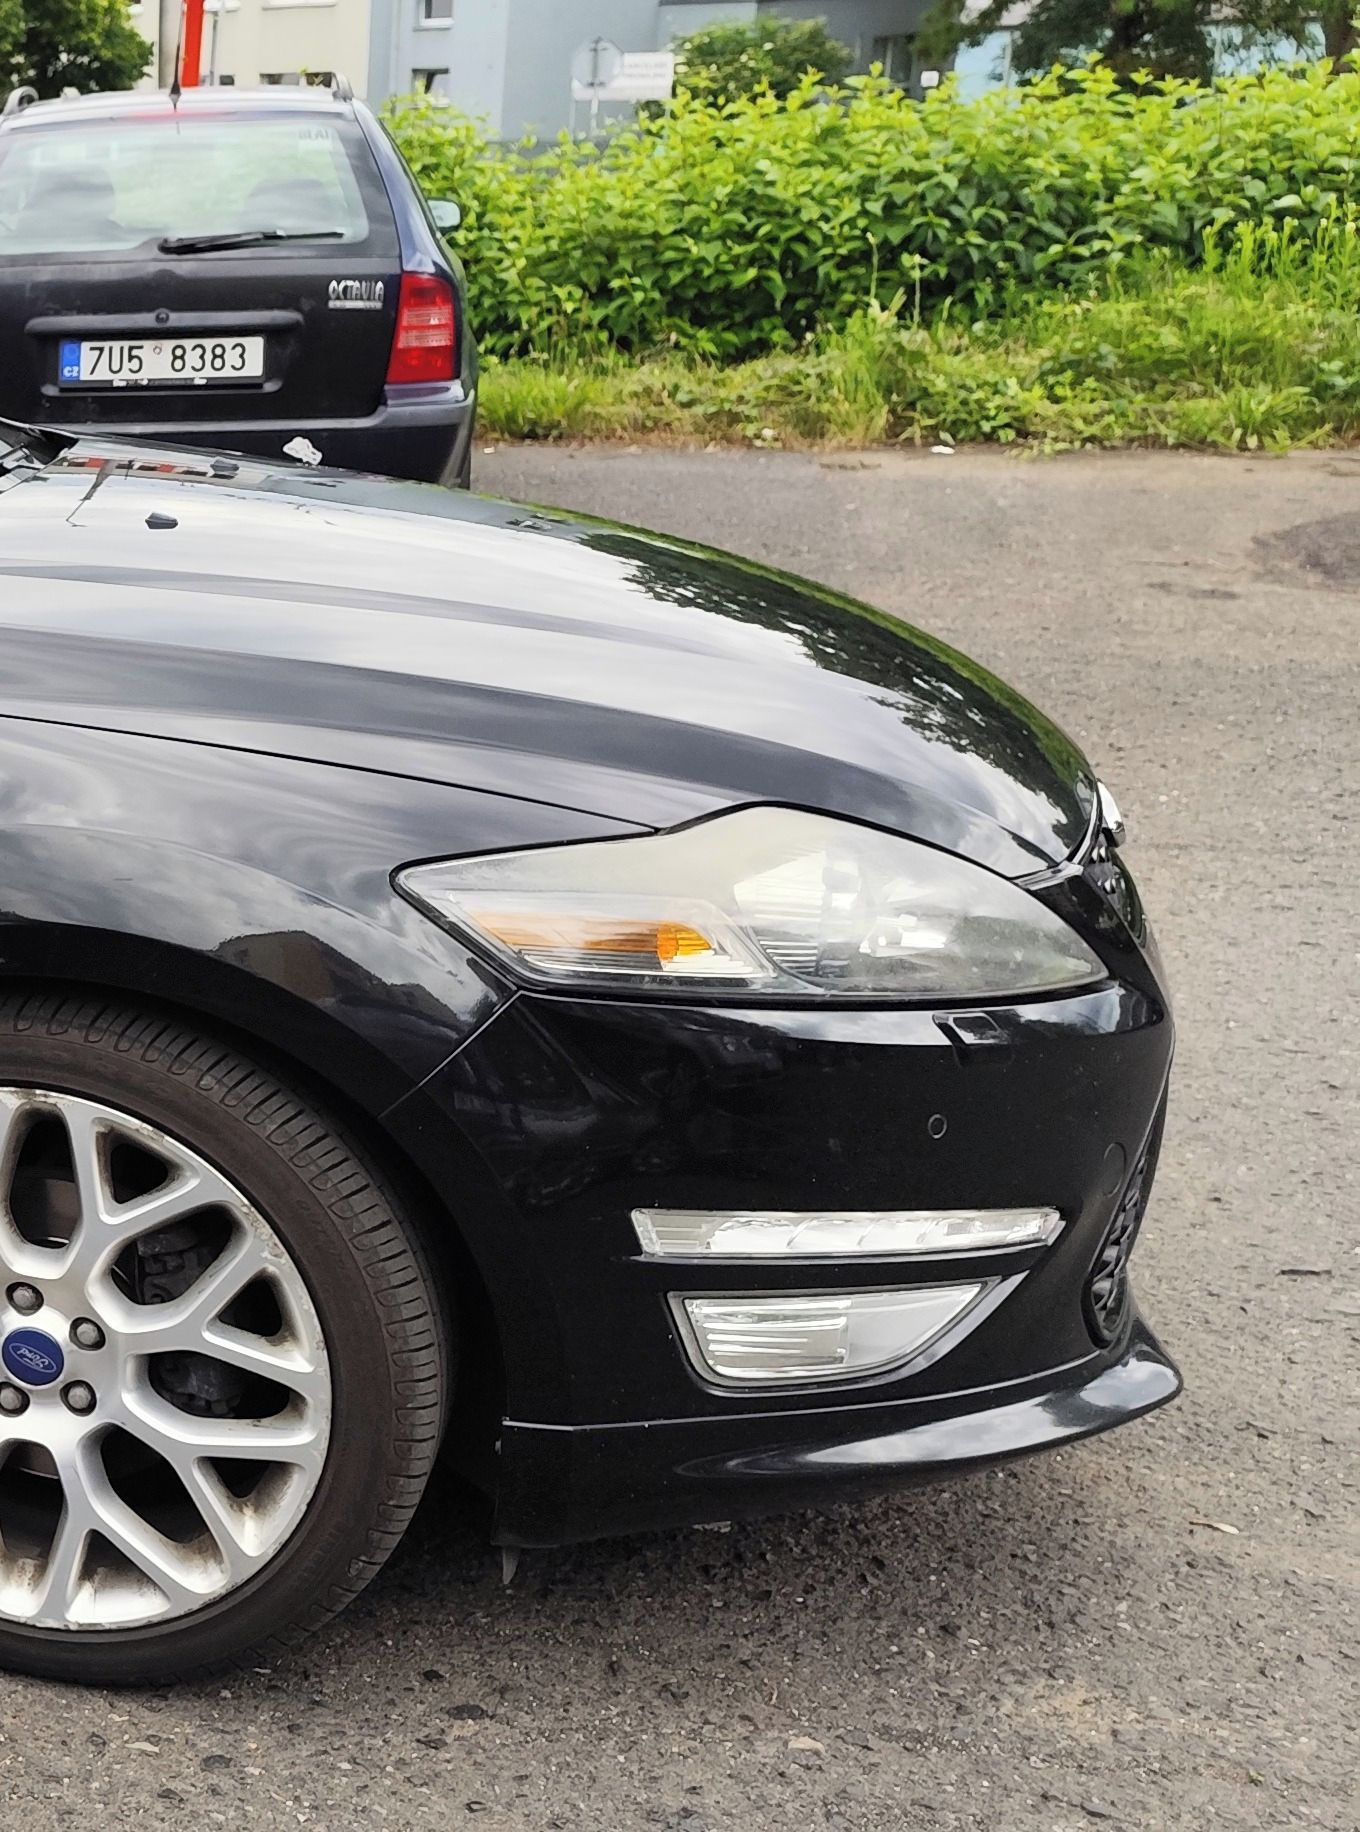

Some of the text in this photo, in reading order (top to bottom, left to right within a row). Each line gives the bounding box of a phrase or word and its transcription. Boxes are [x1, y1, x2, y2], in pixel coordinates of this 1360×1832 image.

[328, 279, 384, 301] OCTAVIA
[89, 345, 144, 375] 7U5
[171, 343, 246, 372] 8383
[17, 1347, 49, 1369] Ford
